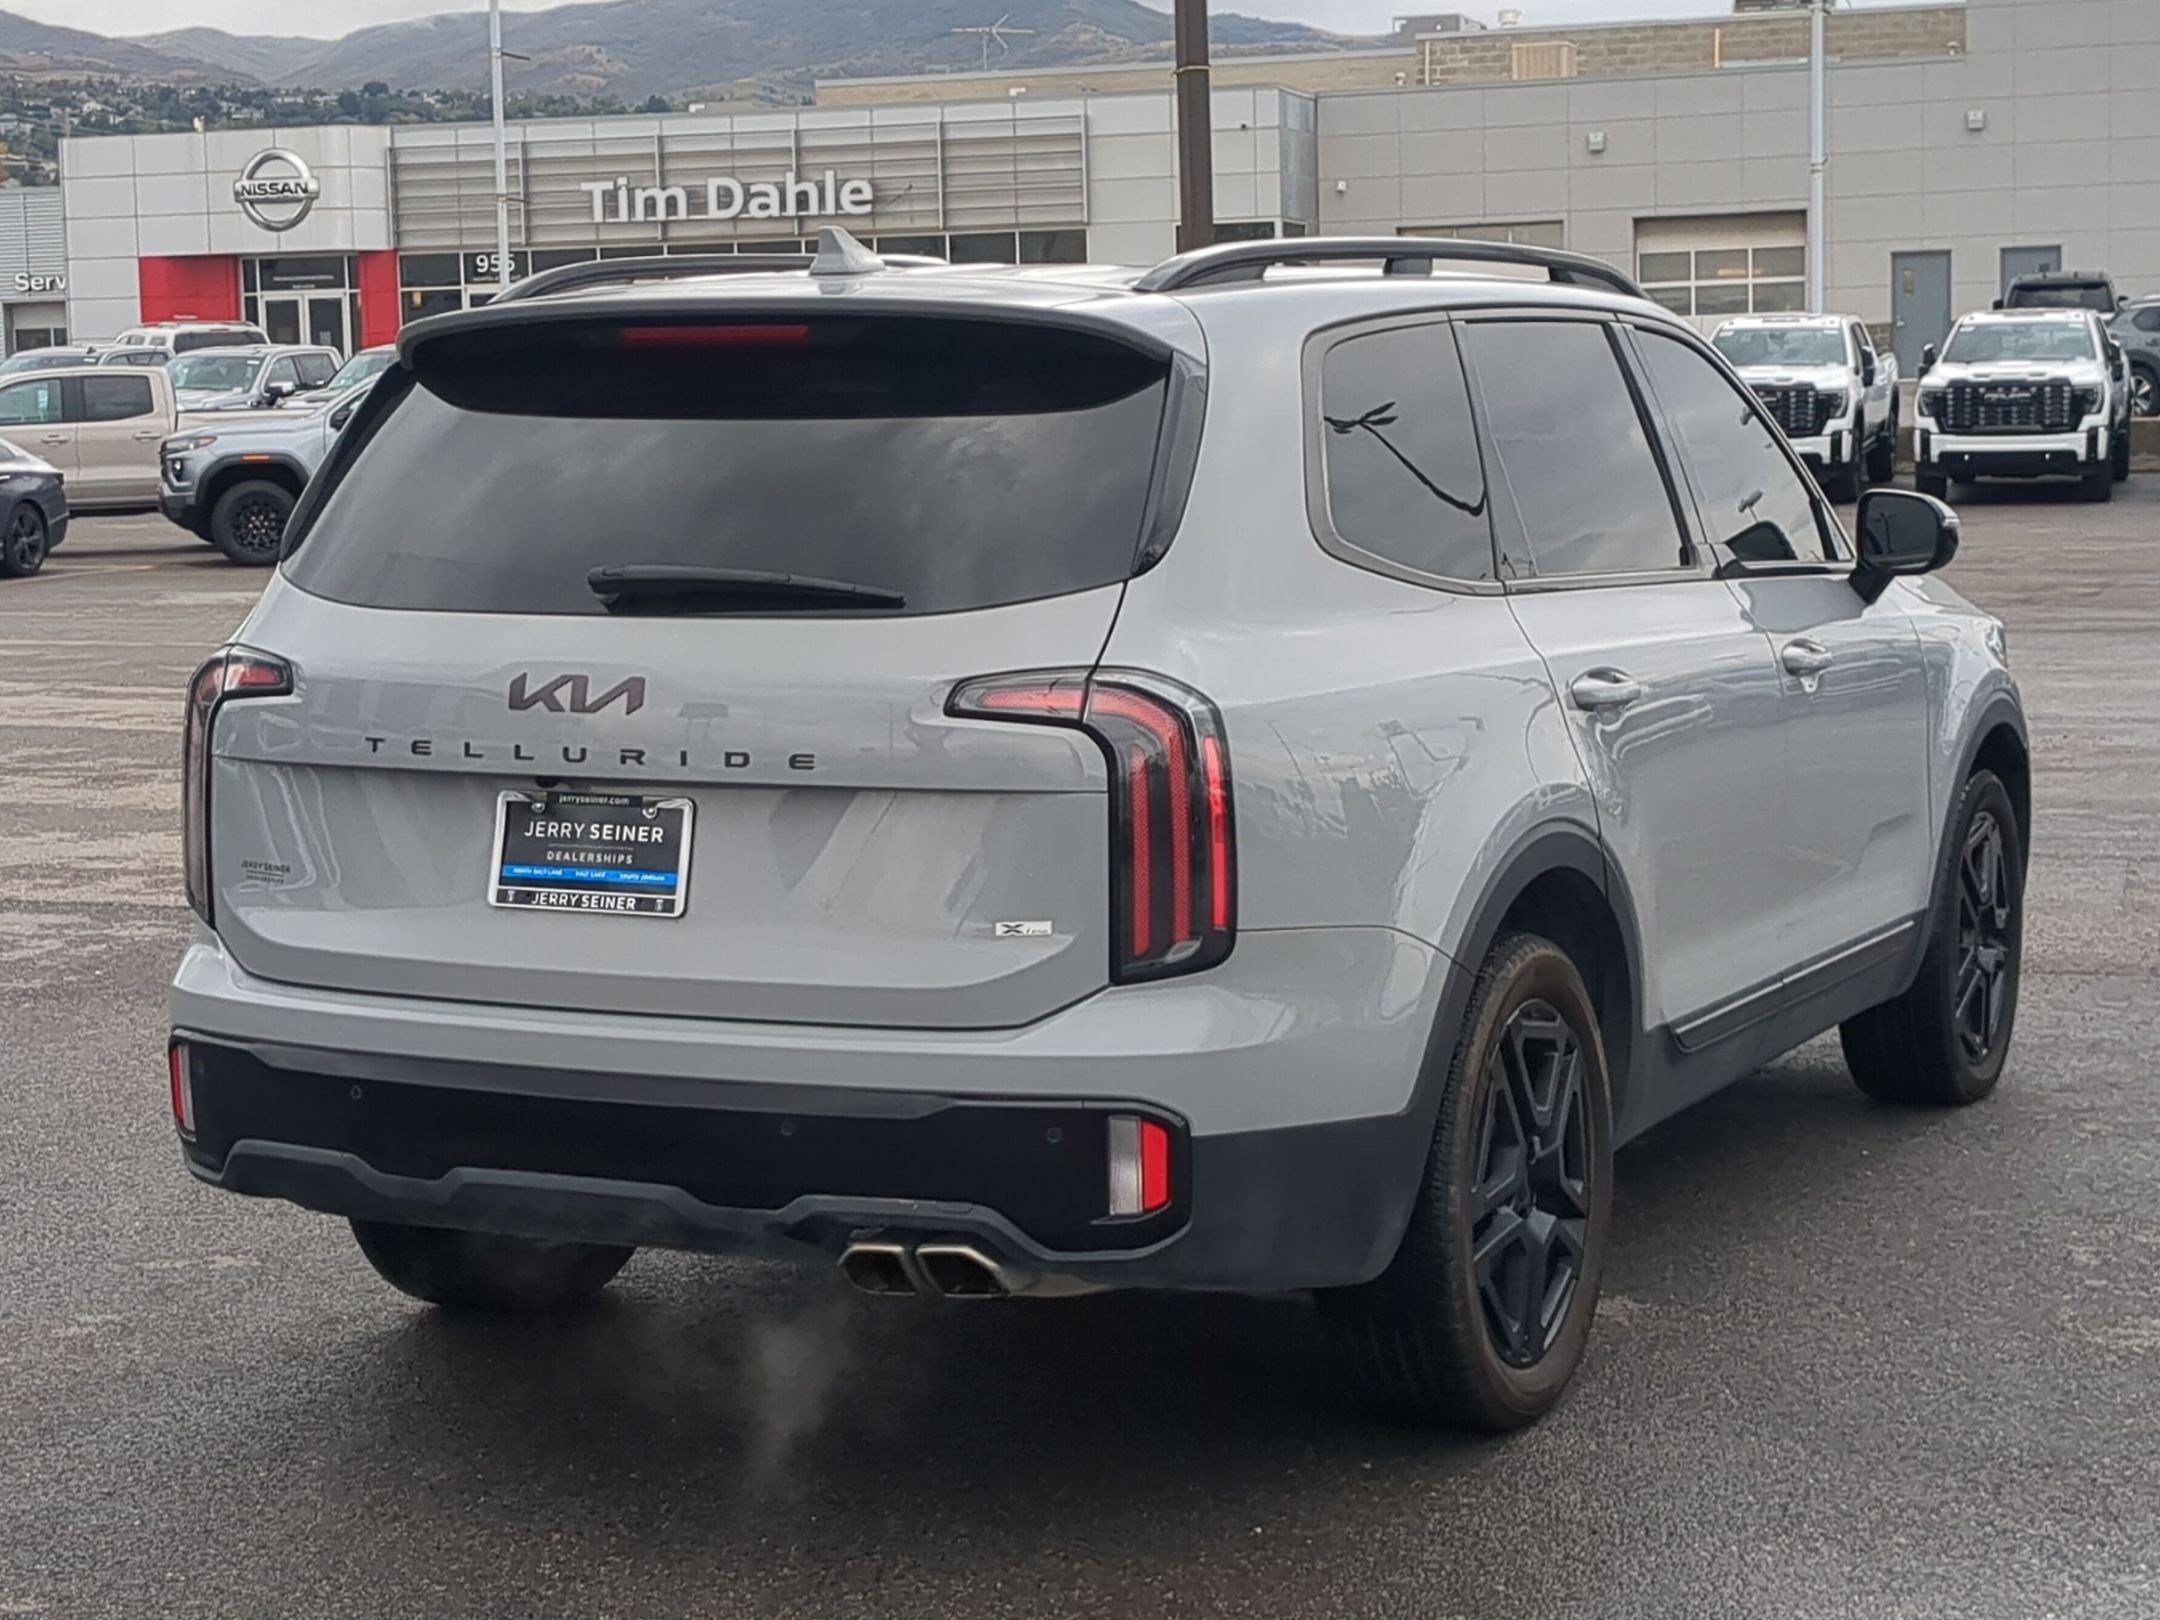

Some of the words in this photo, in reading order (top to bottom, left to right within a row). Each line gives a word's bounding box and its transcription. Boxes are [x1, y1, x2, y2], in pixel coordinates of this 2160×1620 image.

[241, 182, 308, 197] NISSAN
[580, 176, 688, 223] Tim
[707, 170, 874, 219] Dahle
[508, 672, 645, 715] KIA
[364, 737, 816, 770] TELLURIDE
[559, 793, 630, 806] jerryseiner.com
[524, 821, 585, 838] JERRY
[589, 824, 664, 843] SEINER
[546, 851, 633, 865] DEALERSHIPS
[531, 892, 580, 906] JERRY
[580, 894, 636, 910] SEINER
